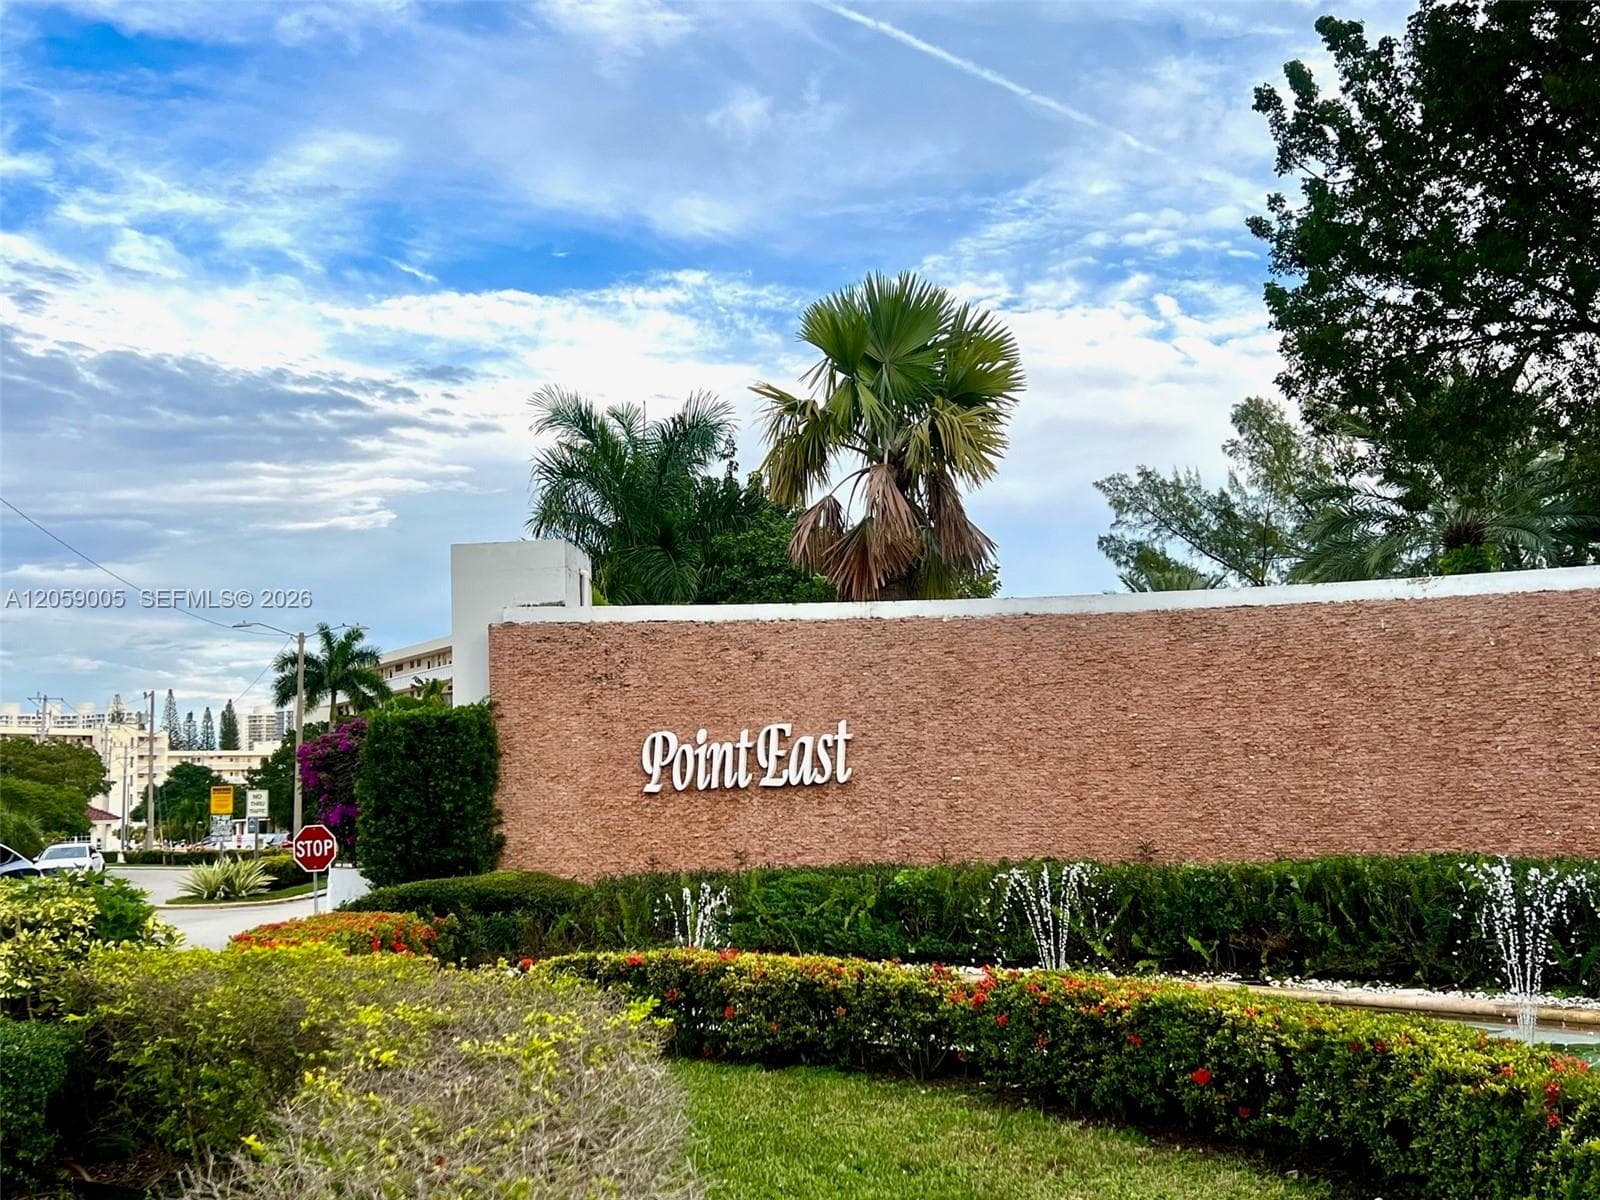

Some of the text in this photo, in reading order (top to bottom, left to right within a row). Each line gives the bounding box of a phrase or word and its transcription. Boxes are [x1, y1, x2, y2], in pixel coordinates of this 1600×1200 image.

[642, 719, 854, 793] Point East
[296, 839, 333, 858] STOP
